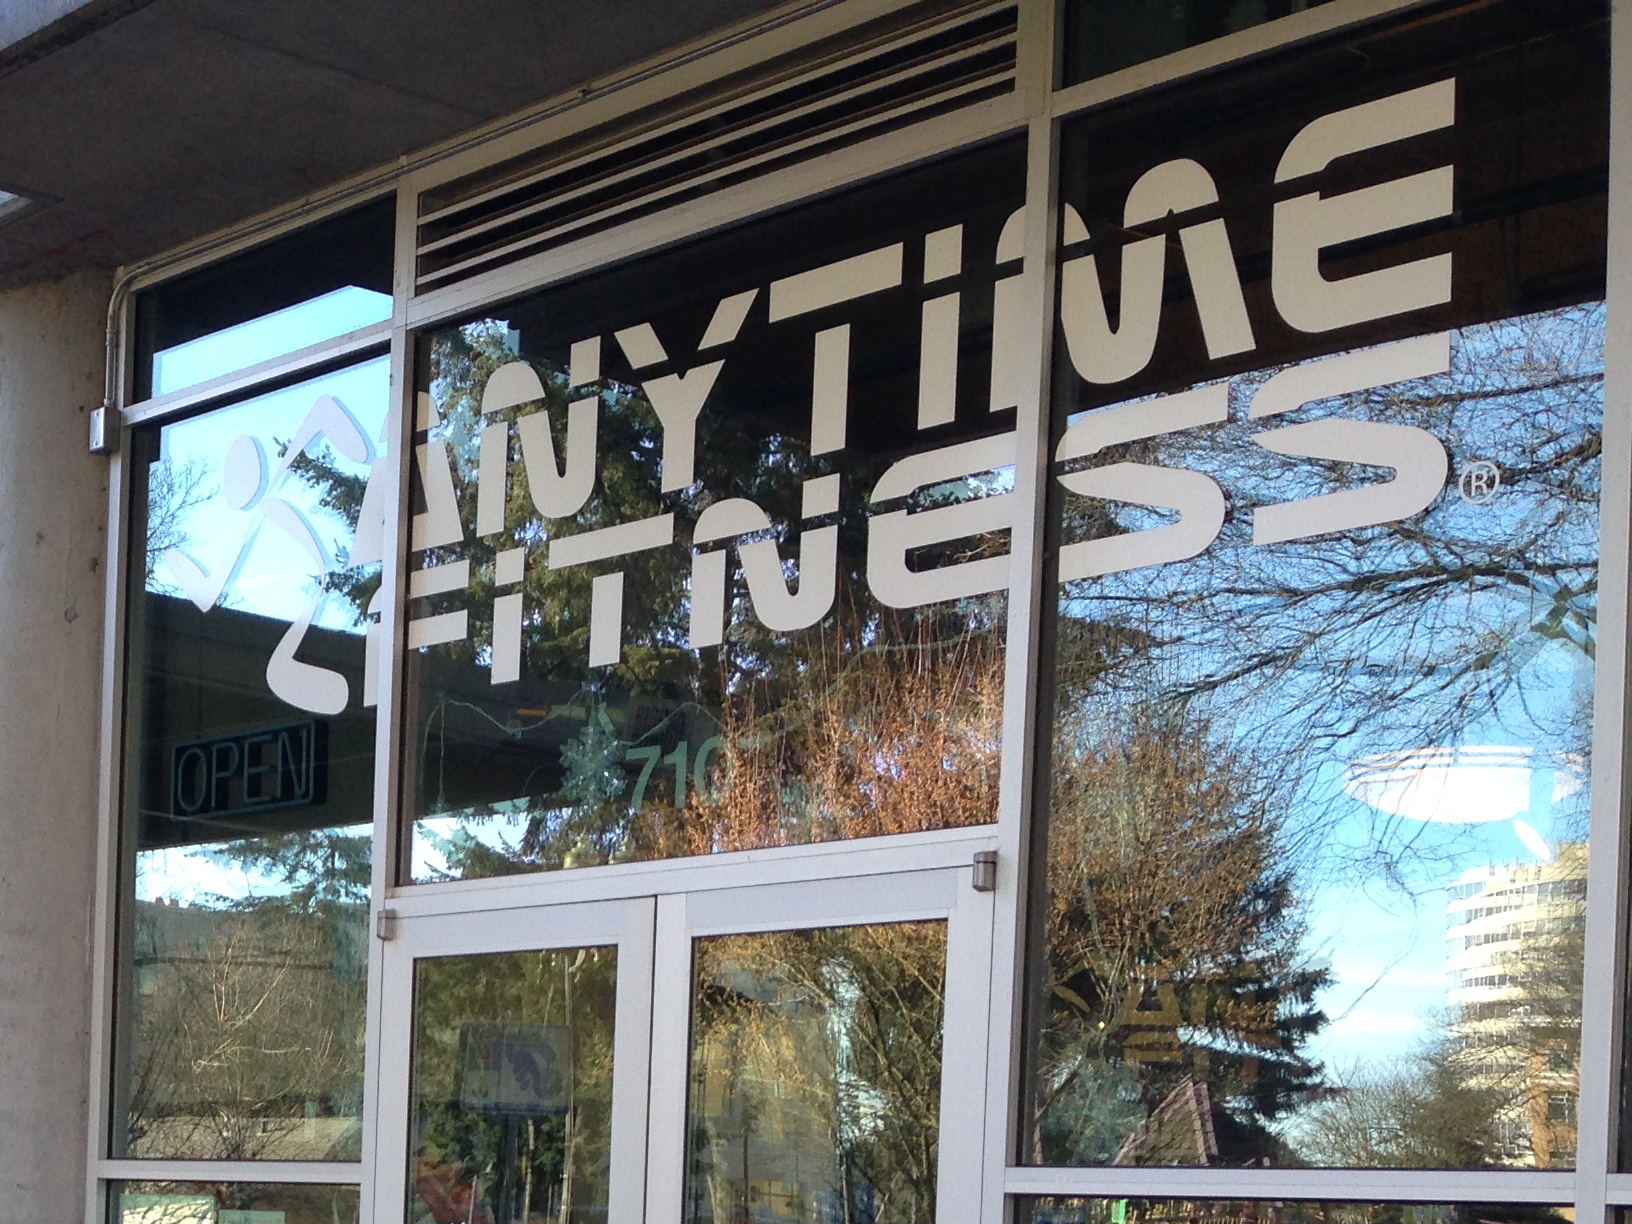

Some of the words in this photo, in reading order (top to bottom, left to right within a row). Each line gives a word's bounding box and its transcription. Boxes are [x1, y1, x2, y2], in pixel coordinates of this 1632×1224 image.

[349, 76, 1457, 568] ANYTIME
[363, 328, 1450, 707] FITNESS
[177, 726, 308, 812] OPEN
